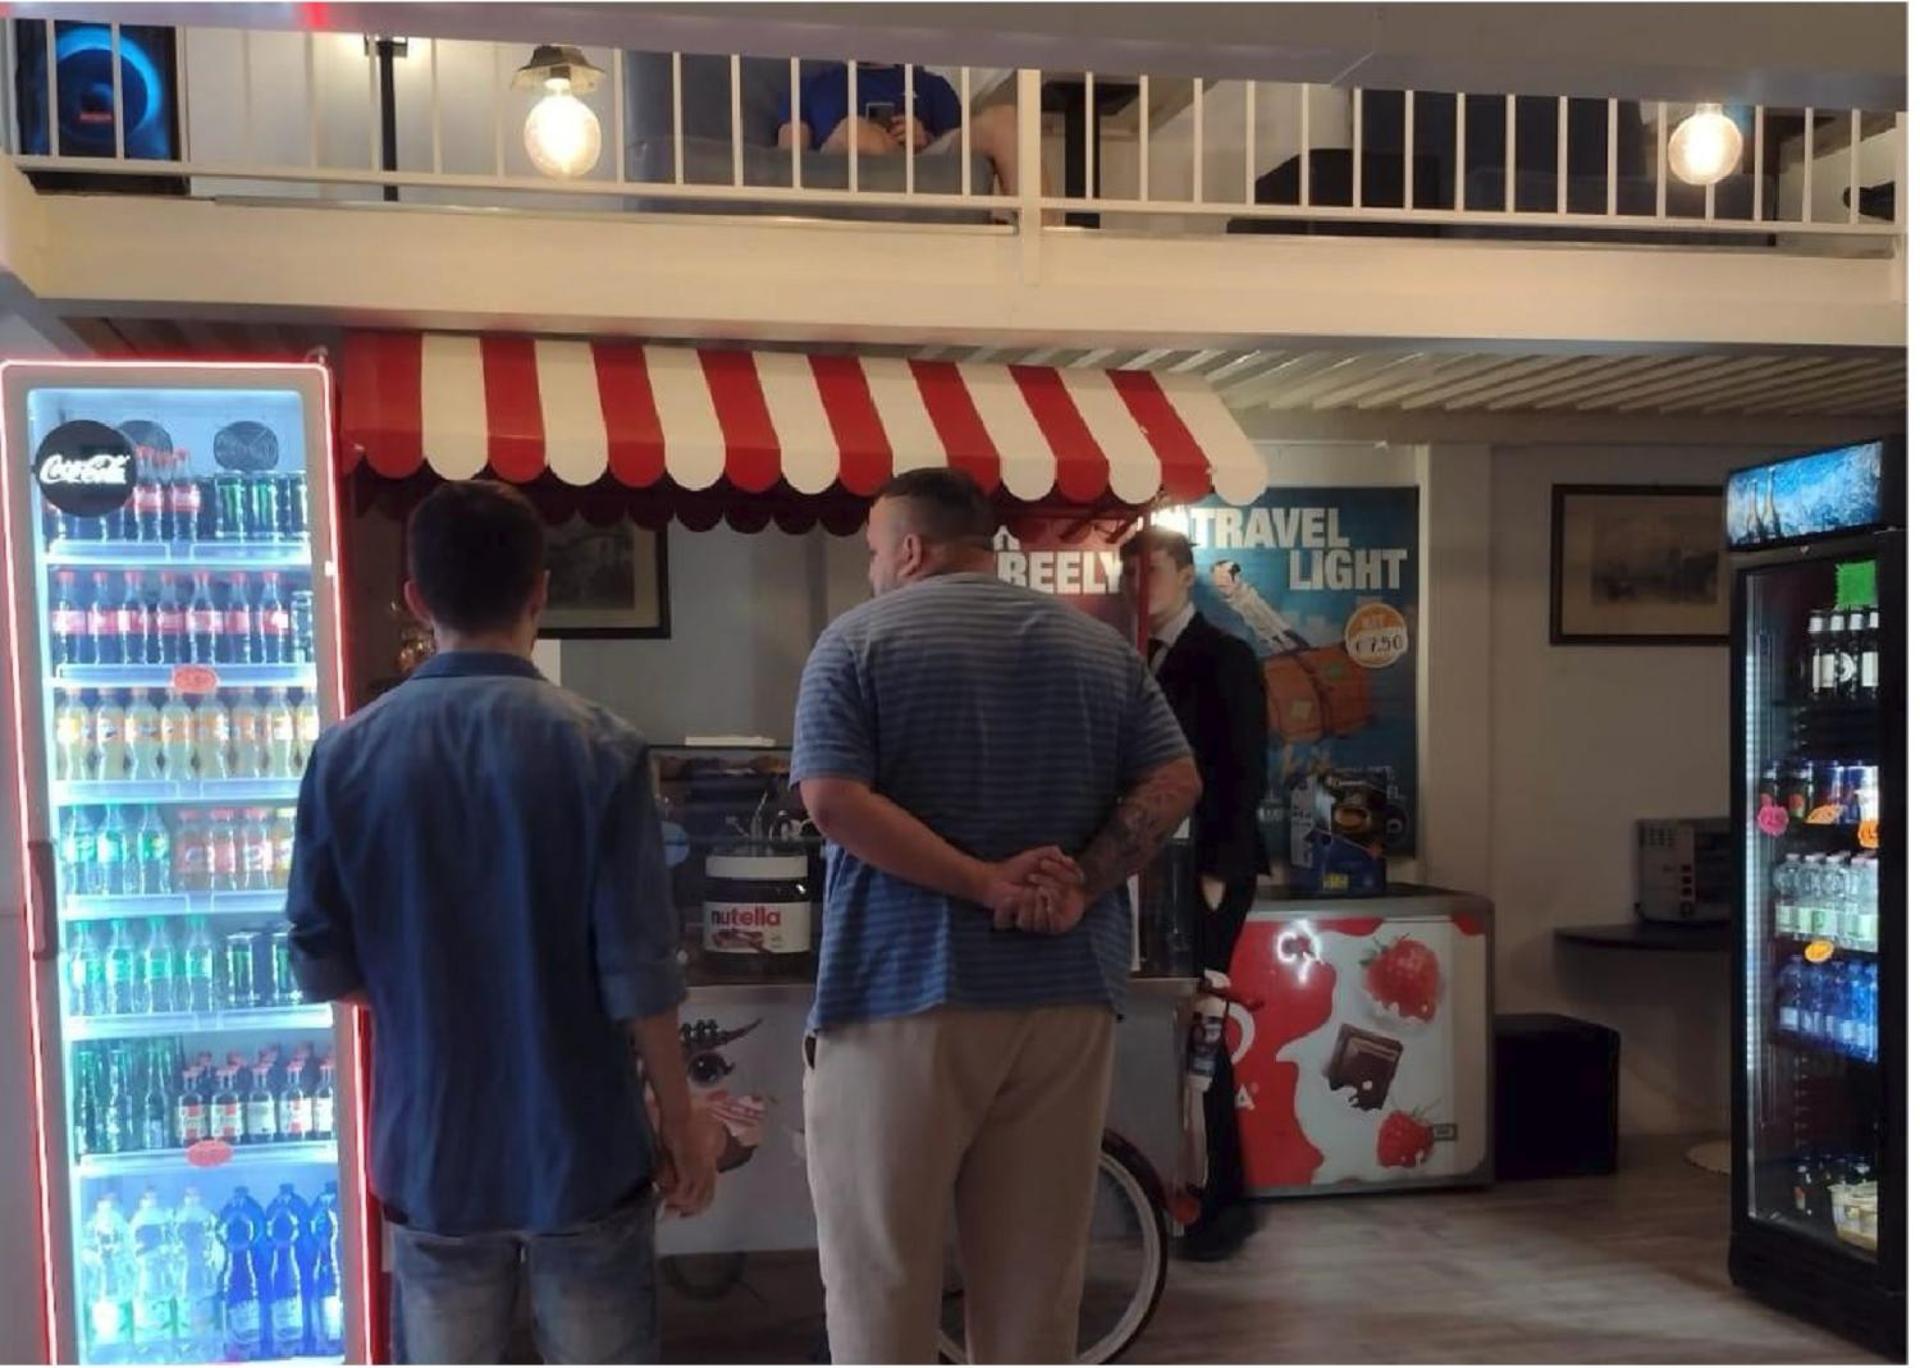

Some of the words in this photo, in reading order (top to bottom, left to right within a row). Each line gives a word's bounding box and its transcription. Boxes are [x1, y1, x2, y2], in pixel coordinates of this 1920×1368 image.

[1190, 507, 1349, 548] TRAVEL
[1289, 549, 1407, 590] LIGHT
[711, 906, 781, 926] nutella
